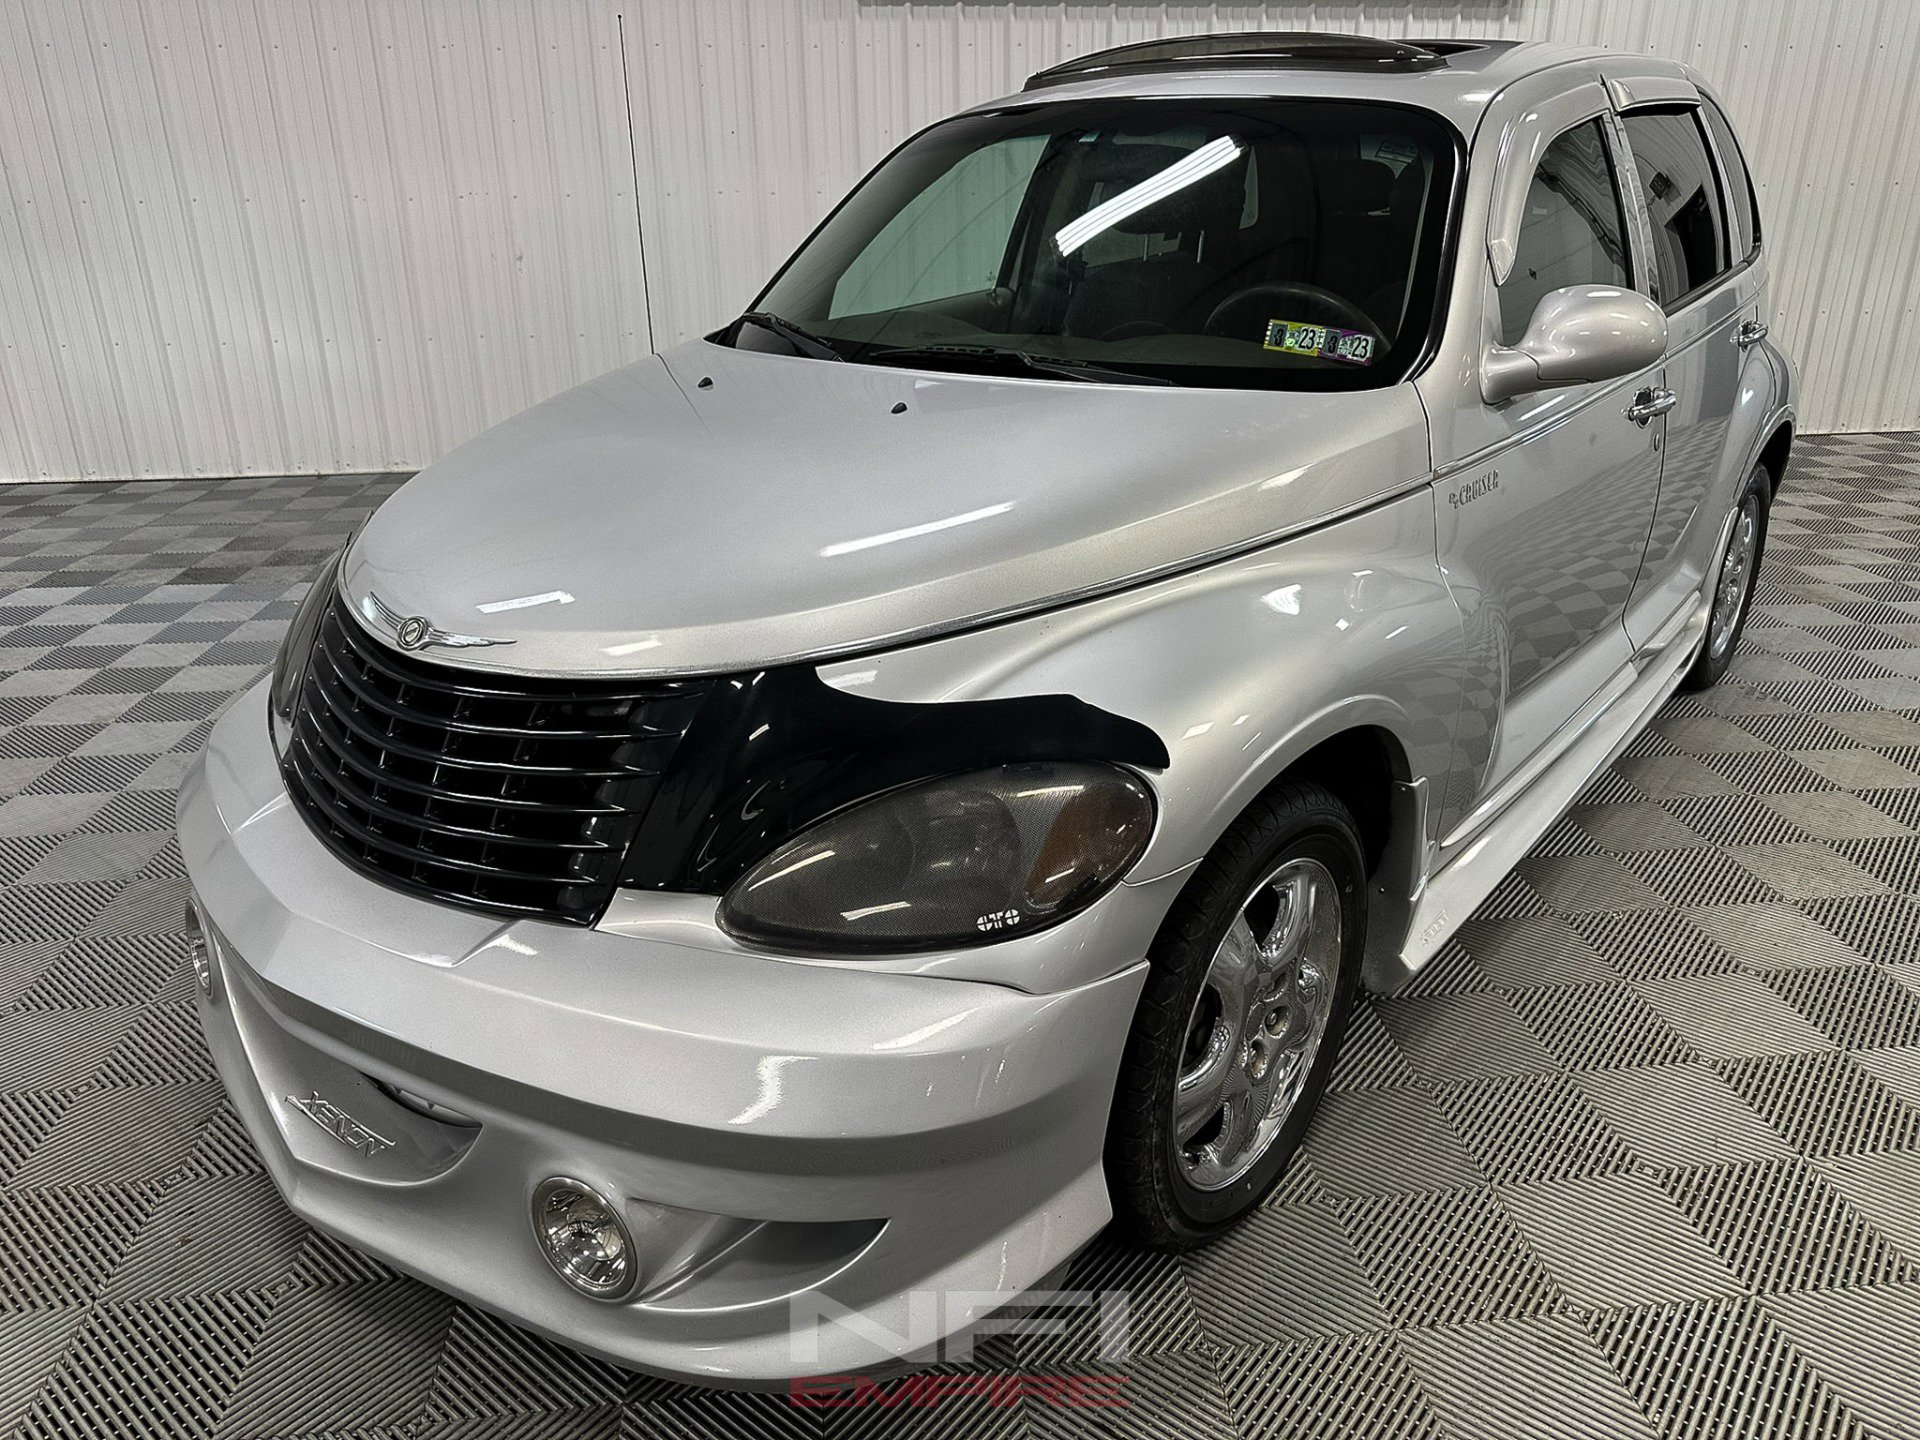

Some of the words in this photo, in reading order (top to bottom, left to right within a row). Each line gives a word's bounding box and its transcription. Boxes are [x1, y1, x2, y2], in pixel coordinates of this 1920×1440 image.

[1273, 328, 1284, 347] 3
[1298, 328, 1316, 350] 23
[1351, 336, 1369, 359] 23
[1459, 469, 1499, 506] CRUISER
[284, 1090, 396, 1158] XENON
